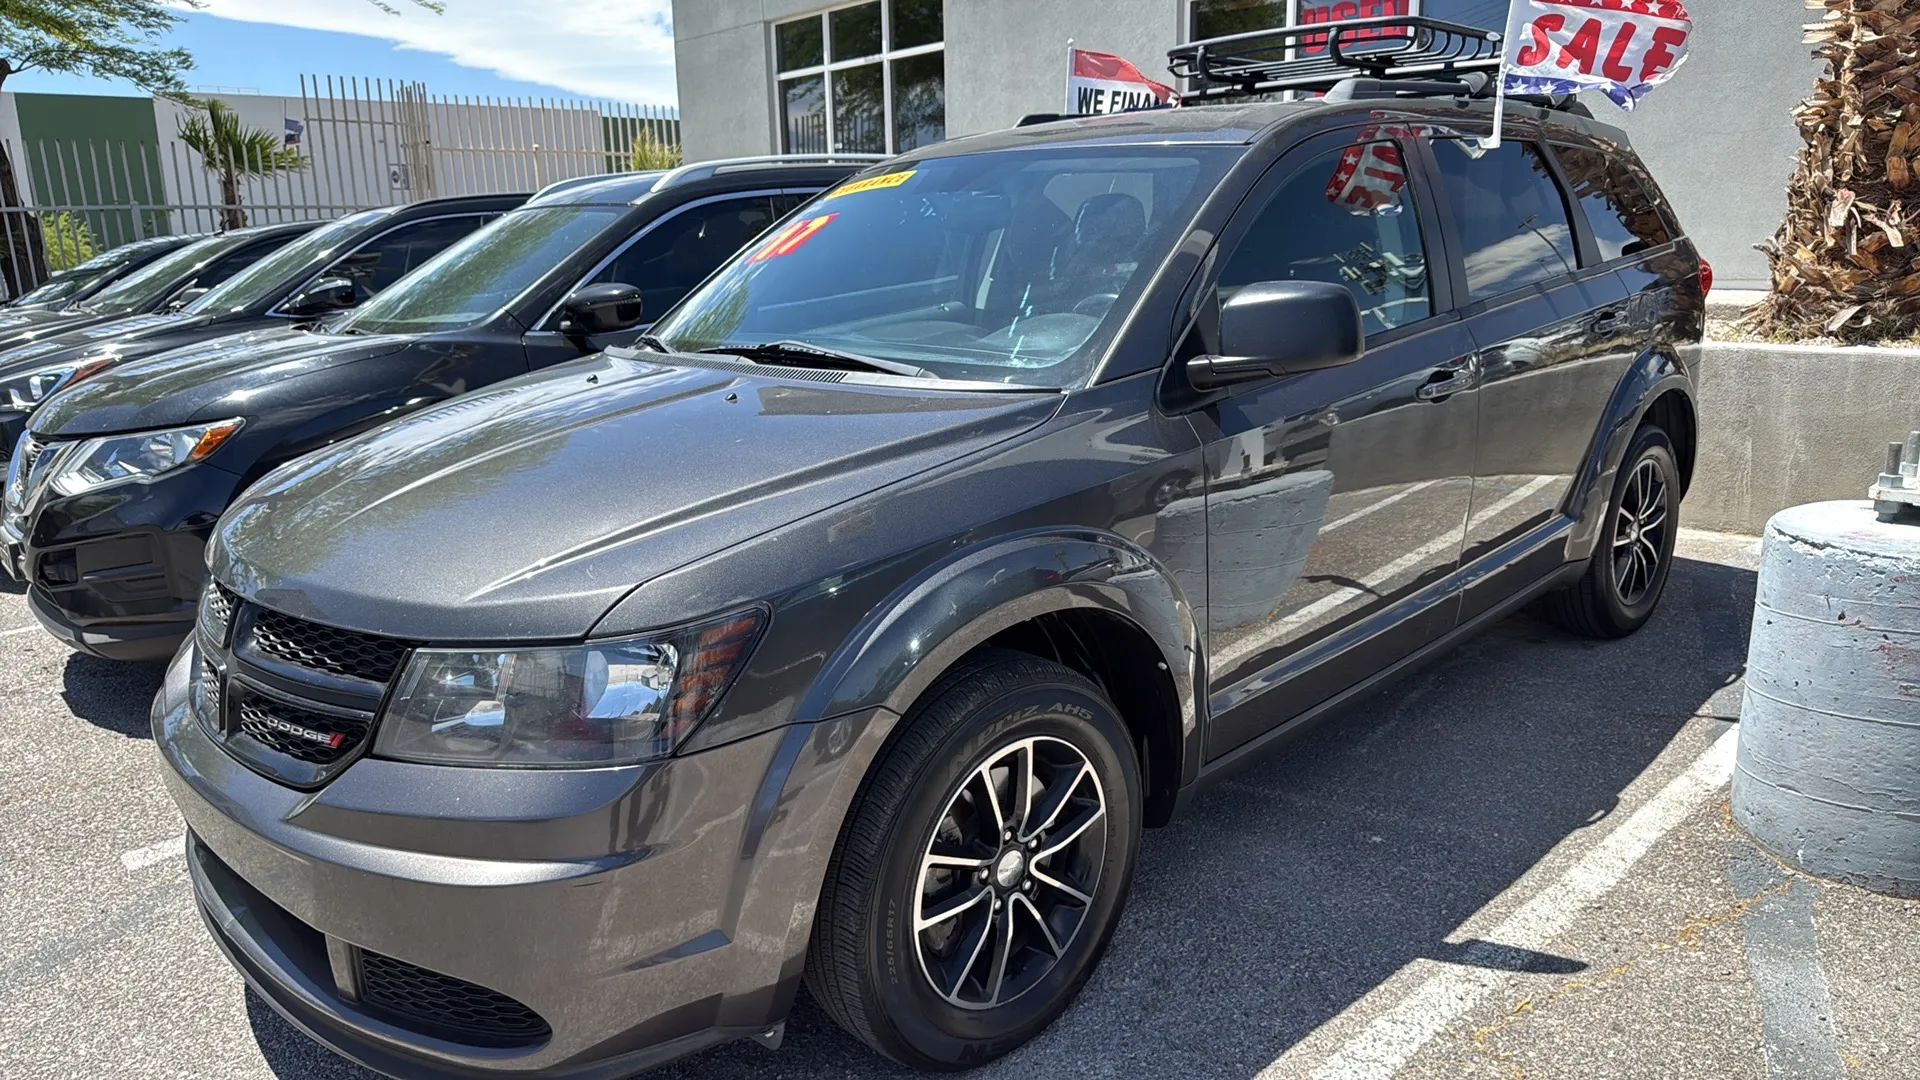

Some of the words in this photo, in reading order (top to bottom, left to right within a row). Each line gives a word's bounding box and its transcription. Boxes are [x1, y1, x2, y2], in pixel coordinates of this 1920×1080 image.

[1302, 0, 1408, 54] USED
[1516, 13, 1687, 83] SALE
[1078, 86, 1105, 114] WE
[1048, 702, 1094, 720] AH5
[267, 716, 331, 744] DODGE
